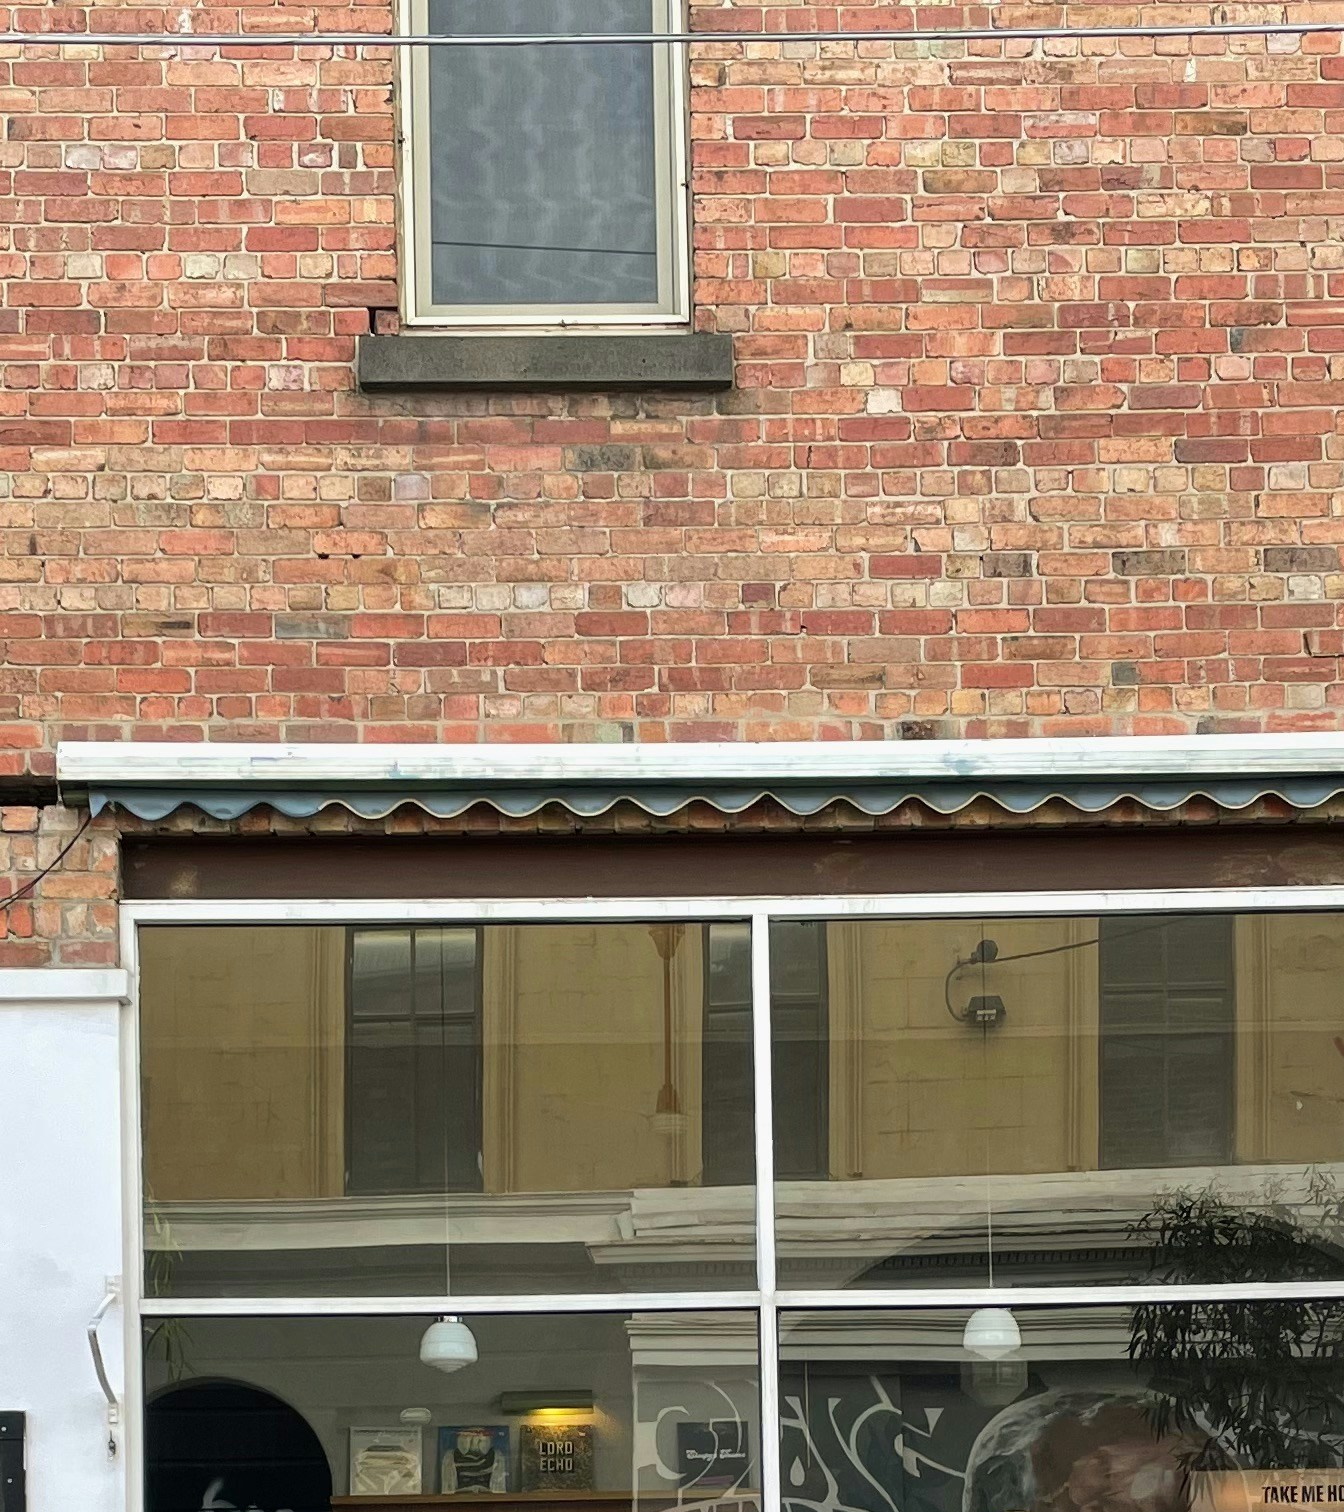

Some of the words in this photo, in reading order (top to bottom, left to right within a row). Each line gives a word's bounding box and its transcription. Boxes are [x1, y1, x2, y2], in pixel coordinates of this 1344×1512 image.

[540, 1457, 574, 1471] ECHO
[1261, 1485, 1298, 1503] TAKE
[1302, 1485, 1324, 1503] ME
